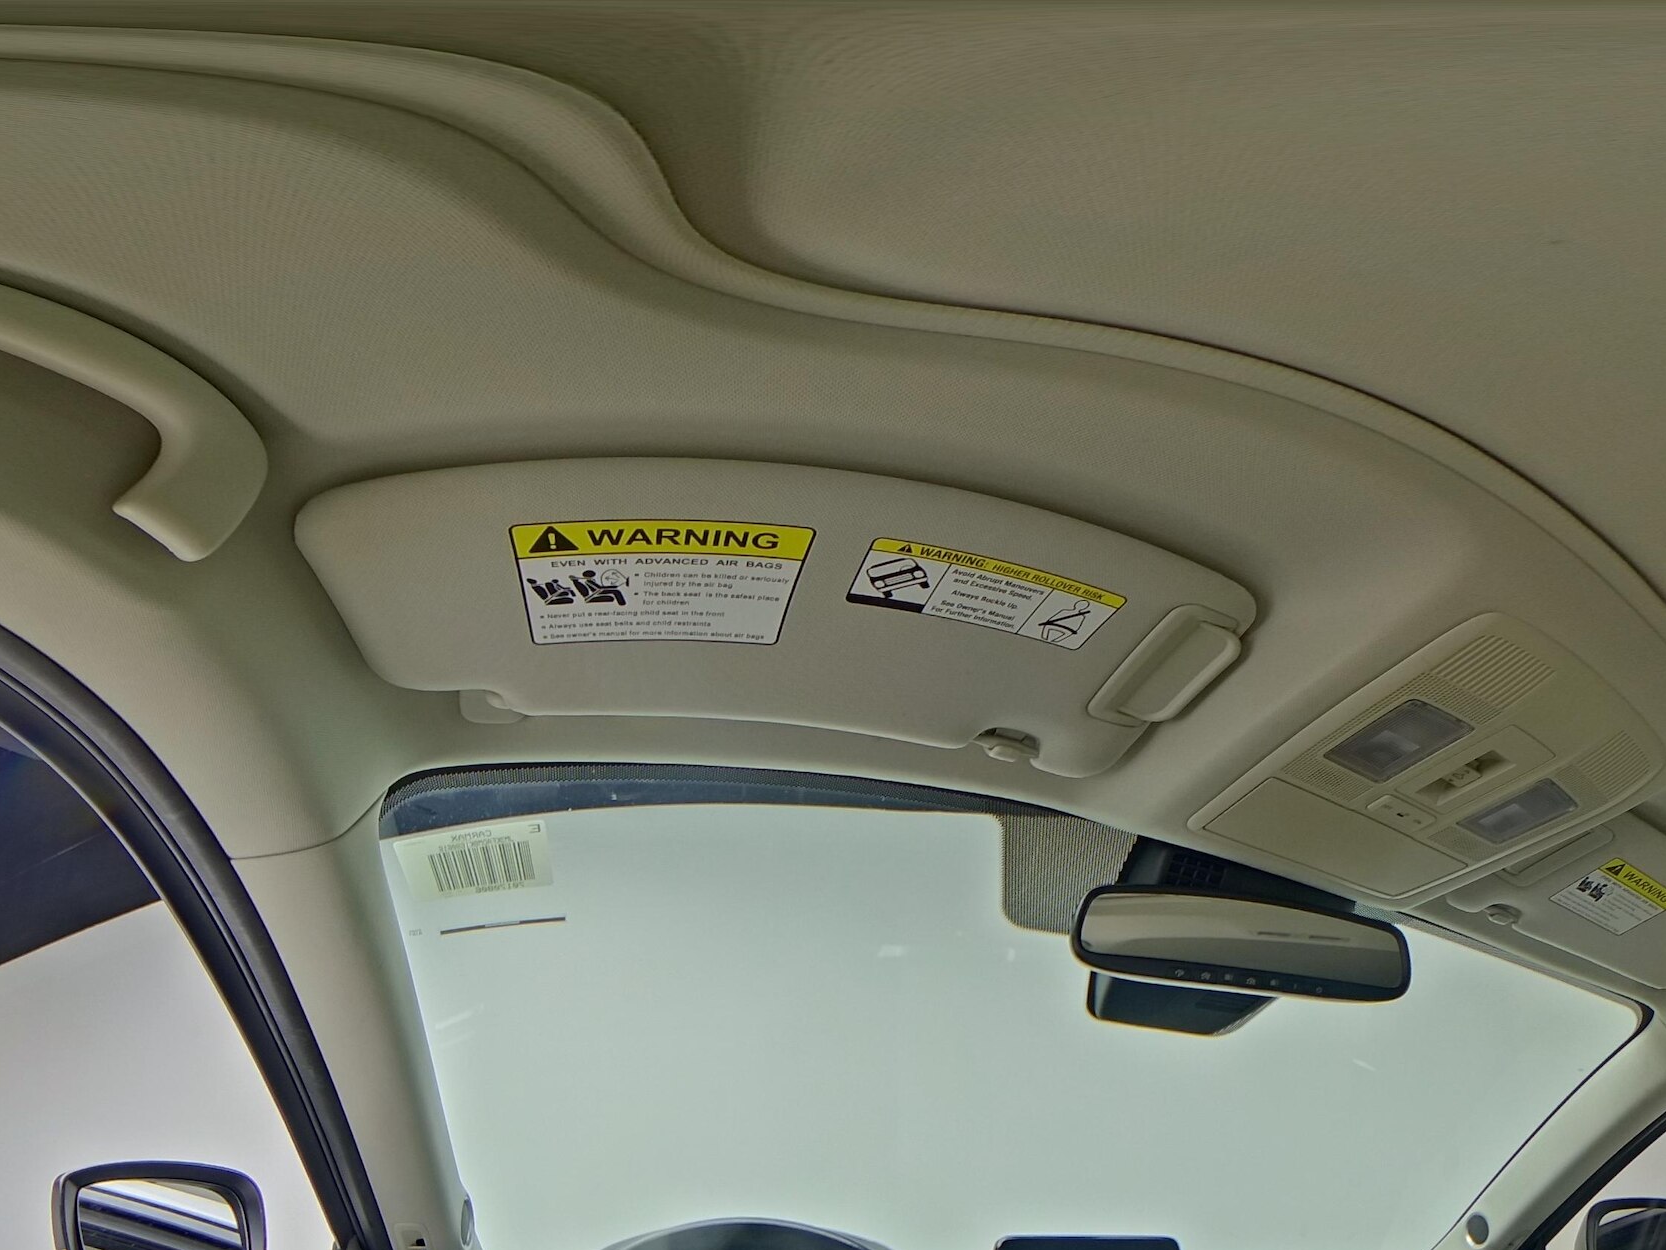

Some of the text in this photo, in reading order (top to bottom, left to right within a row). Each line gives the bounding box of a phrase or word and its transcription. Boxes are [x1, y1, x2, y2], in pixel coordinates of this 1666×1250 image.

[586, 528, 780, 550] WARNING
[550, 557, 783, 570] EVEN WITH ADVANCED AIR BAGS
[750, 575, 790, 584] seriously
[920, 546, 1105, 601] WARNING: HIGHER ROLLOVER RISK
[951, 568, 1045, 596] Avoid Abrupt Maneuvers
[969, 580, 1007, 594] Excessive
[951, 589, 979, 601] Always
[980, 596, 1006, 607] Buckle
[931, 605, 945, 613] For
[944, 607, 973, 618] Further
[956, 601, 987, 615] Owner's
[988, 610, 1016, 621] Manual
